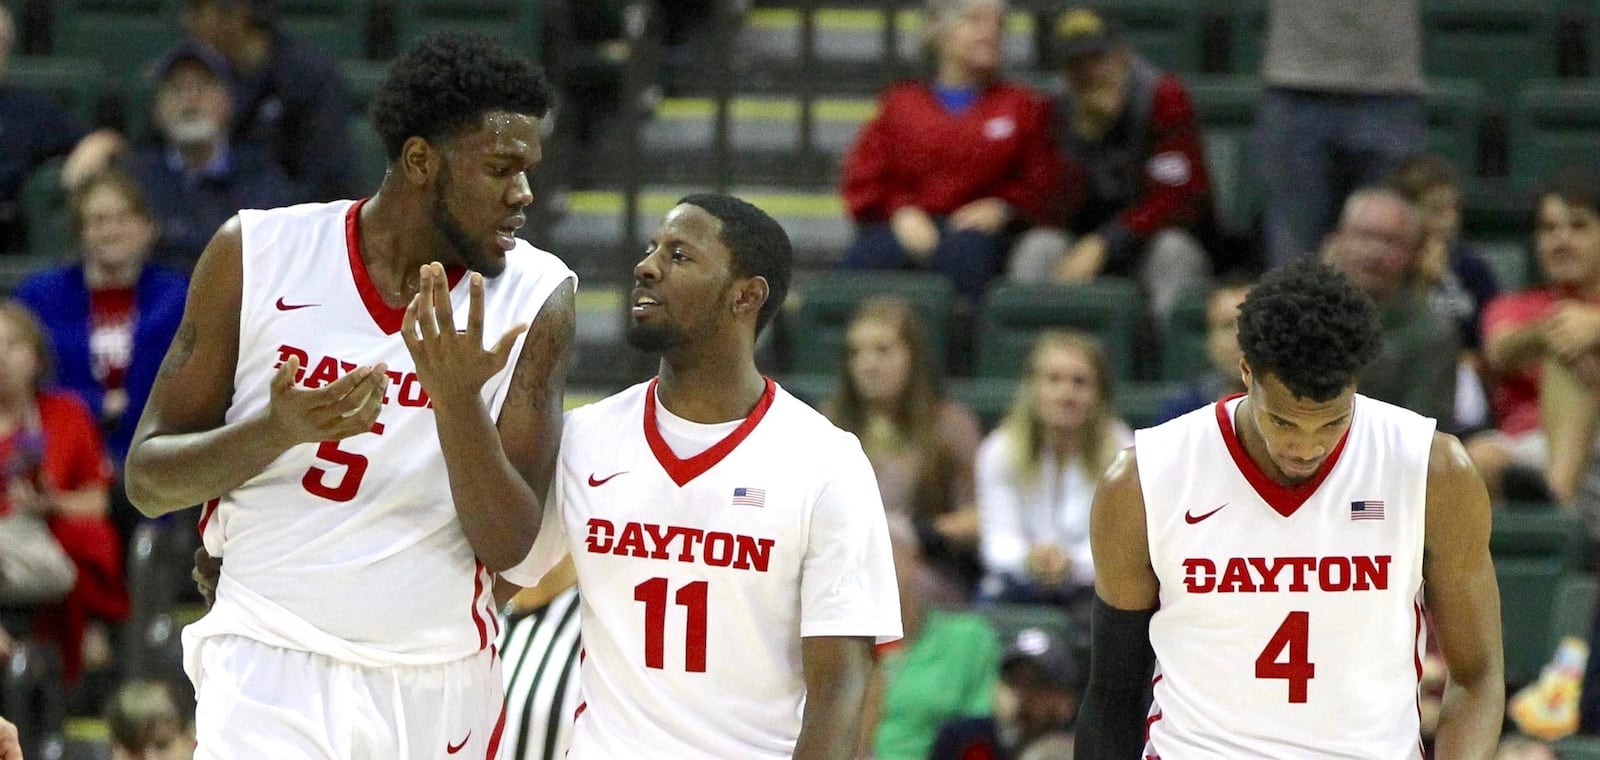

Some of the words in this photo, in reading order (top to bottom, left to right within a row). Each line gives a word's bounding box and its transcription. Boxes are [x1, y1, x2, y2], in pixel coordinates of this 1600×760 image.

[301, 422, 385, 502] 5
[585, 518, 775, 572] DAYTON
[1182, 555, 1392, 593] DAYTON
[634, 577, 708, 673] 11
[1255, 611, 1315, 703] 4
